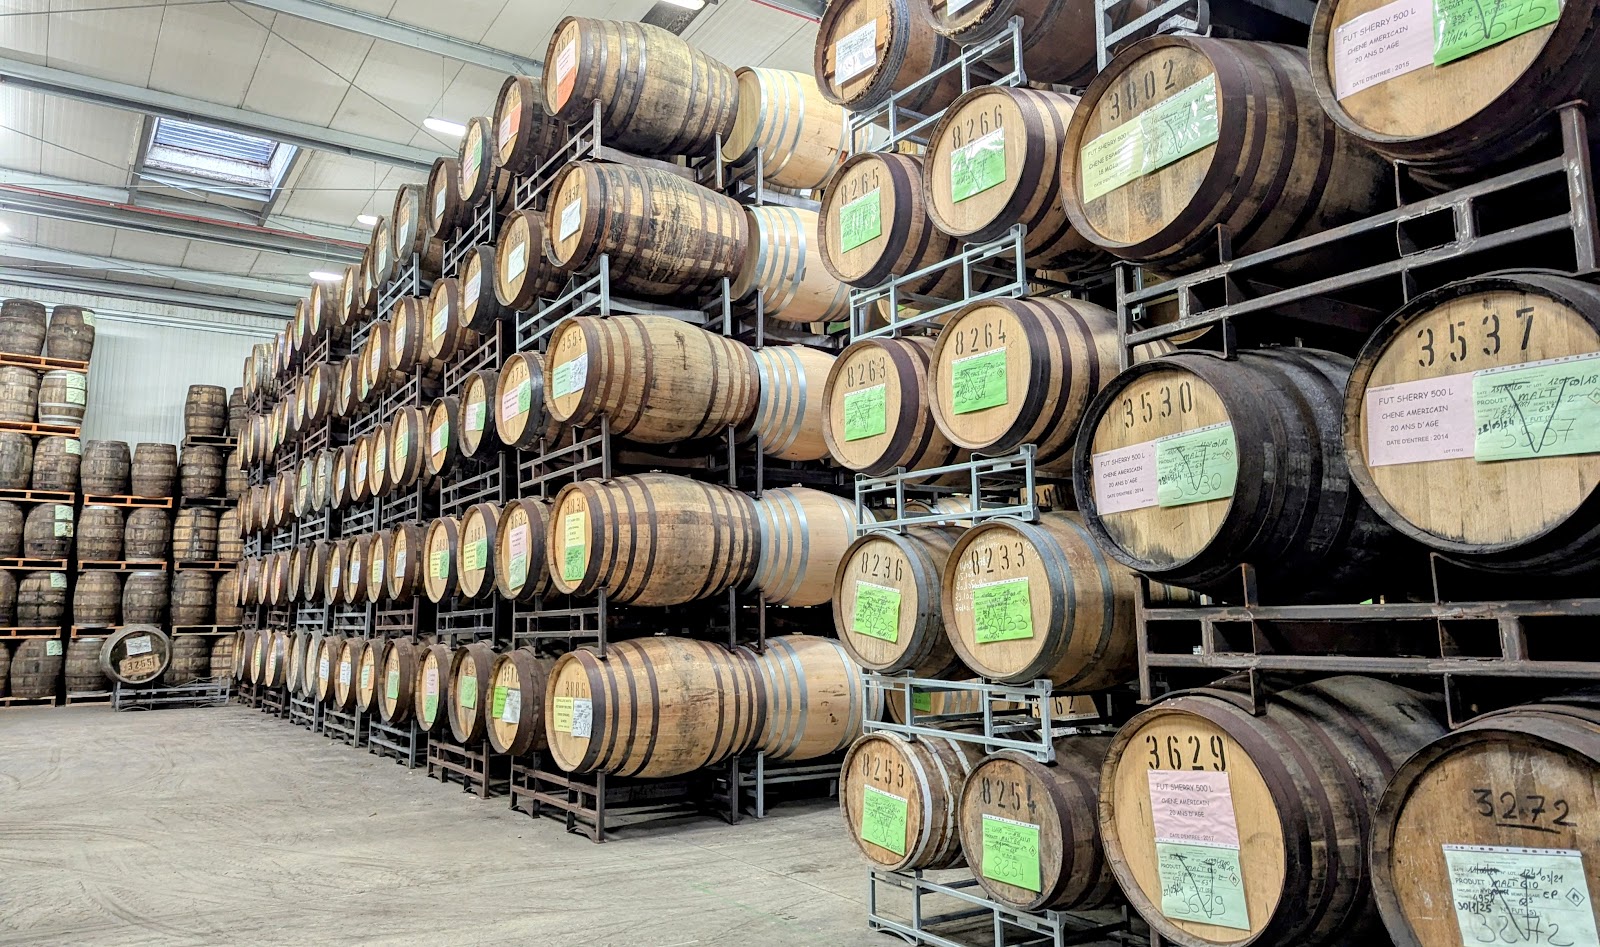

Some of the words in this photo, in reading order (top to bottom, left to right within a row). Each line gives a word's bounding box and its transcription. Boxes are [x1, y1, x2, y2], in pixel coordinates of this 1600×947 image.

[1342, 30, 1358, 44] FUT
[1359, 15, 1391, 36] SHERRY
[1393, 10, 1409, 22] 500
[1347, 41, 1368, 56] CHENE
[1368, 25, 1409, 46] AMERICAIN
[1354, 56, 1362, 64] 20
[1363, 49, 1378, 60] ANS
[1378, 40, 1400, 54] D'AGE
[1109, 59, 1176, 120] 3802
[1352, 78, 1365, 88] DATE
[1366, 68, 1391, 82] D'ENTREE
[1395, 61, 1410, 71] 2015
[952, 104, 1003, 150] 8266
[1087, 148, 1098, 158] FUT
[841, 167, 879, 206] 8265
[956, 319, 1006, 356] 8264
[1418, 306, 1534, 368] 3537
[848, 356, 886, 388] 8263
[1123, 381, 1193, 428] 3530
[1378, 396, 1394, 406] FUT
[1396, 391, 1429, 403] SHERRY
[1430, 388, 1447, 398] 500
[1448, 388, 1454, 396] L
[1476, 396, 1508, 406] PRODUIT
[1518, 388, 1556, 401] MALT
[1382, 411, 1405, 420] CHENE
[1406, 405, 1449, 416] AMERICAIN
[1400, 422, 1416, 431] ANS
[1417, 420, 1440, 429] D'AGE
[1402, 436, 1430, 444] D'ENTREE
[1100, 460, 1110, 468] FUT
[1112, 456, 1130, 466] SHERRY
[1118, 466, 1143, 476] AMERICAIN
[862, 552, 902, 582] 8236
[972, 542, 1026, 576] 8233
[988, 614, 1028, 634] 8233
[1146, 736, 1226, 772] 3629
[862, 752, 904, 788] 8253
[982, 777, 1037, 814] 8254
[1156, 782, 1168, 790] FUT
[1170, 784, 1194, 792] SHERRY
[1196, 784, 1208, 792] 500
[1473, 788, 1578, 827] 3272
[994, 856, 1024, 880] 8254
[1491, 878, 1518, 888] MALT
[1474, 913, 1574, 946] 3272
